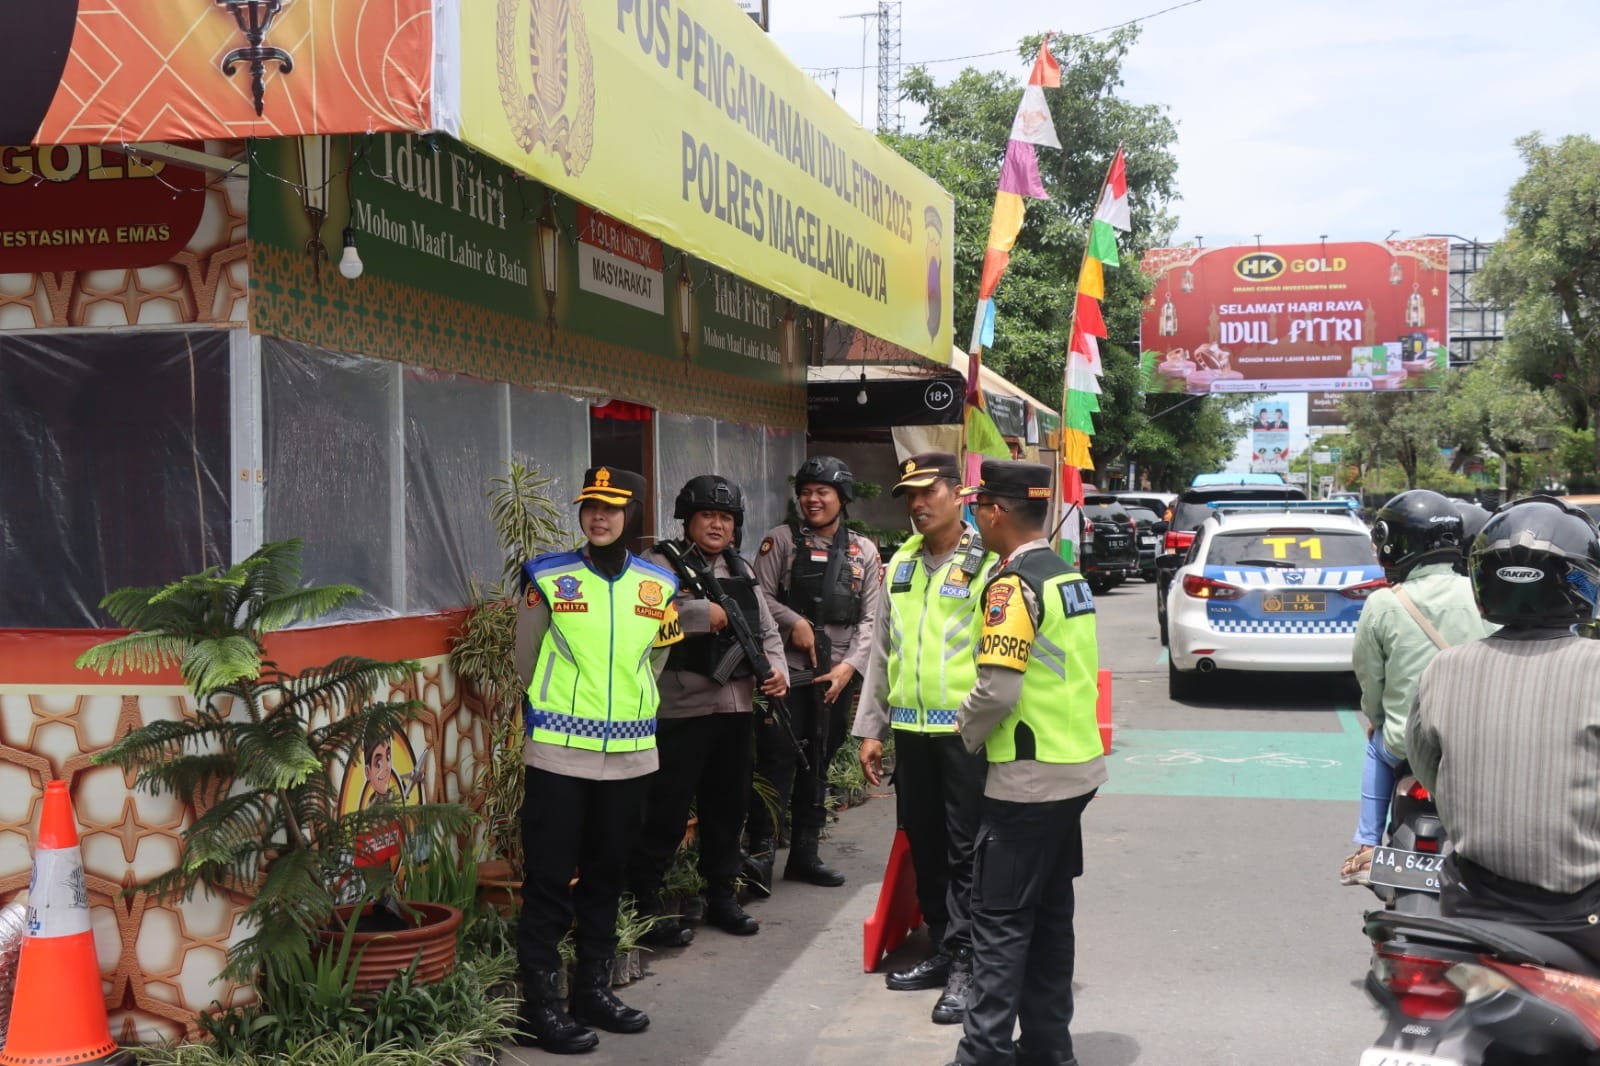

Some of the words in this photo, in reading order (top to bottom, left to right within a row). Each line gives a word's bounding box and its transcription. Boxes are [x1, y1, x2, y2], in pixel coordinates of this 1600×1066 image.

[676, 8, 815, 178] PENGAMANAN
[817, 130, 850, 203] IDUL
[851, 159, 884, 227] FITRI
[885, 187, 913, 244] 2025
[383, 132, 443, 204] Idul
[449, 152, 507, 230] Fitri
[681, 130, 764, 243] POLRES
[768, 187, 854, 290] MAGELANG
[856, 243, 888, 305] KOTA
[0, 228, 110, 248] ESTASINYA
[116, 225, 170, 243] EMAS
[355, 198, 408, 246] Mohon
[411, 220, 446, 259] Maaf
[449, 234, 483, 271] Lahir
[485, 249, 497, 276] &
[499, 252, 528, 287] Batin
[621, 231, 651, 264] UNTUK
[592, 256, 653, 299] MASYARAKAT
[1242, 259, 1278, 274] HK
[1290, 257, 1347, 273] GOLD
[714, 273, 741, 320] Idul
[1219, 303, 1285, 315] SELAMAT
[1287, 301, 1323, 313] HARI
[1325, 300, 1363, 312] RAYA
[1219, 321, 1279, 345] IDUL
[1288, 317, 1363, 343] FITRI
[929, 390, 949, 402] 18+
[1262, 537, 1322, 560] T1
[942, 586, 969, 597] POLRI
[556, 603, 586, 611] ANITA
[1375, 850, 1395, 867] AA
[1405, 854, 1445, 872] 6424
